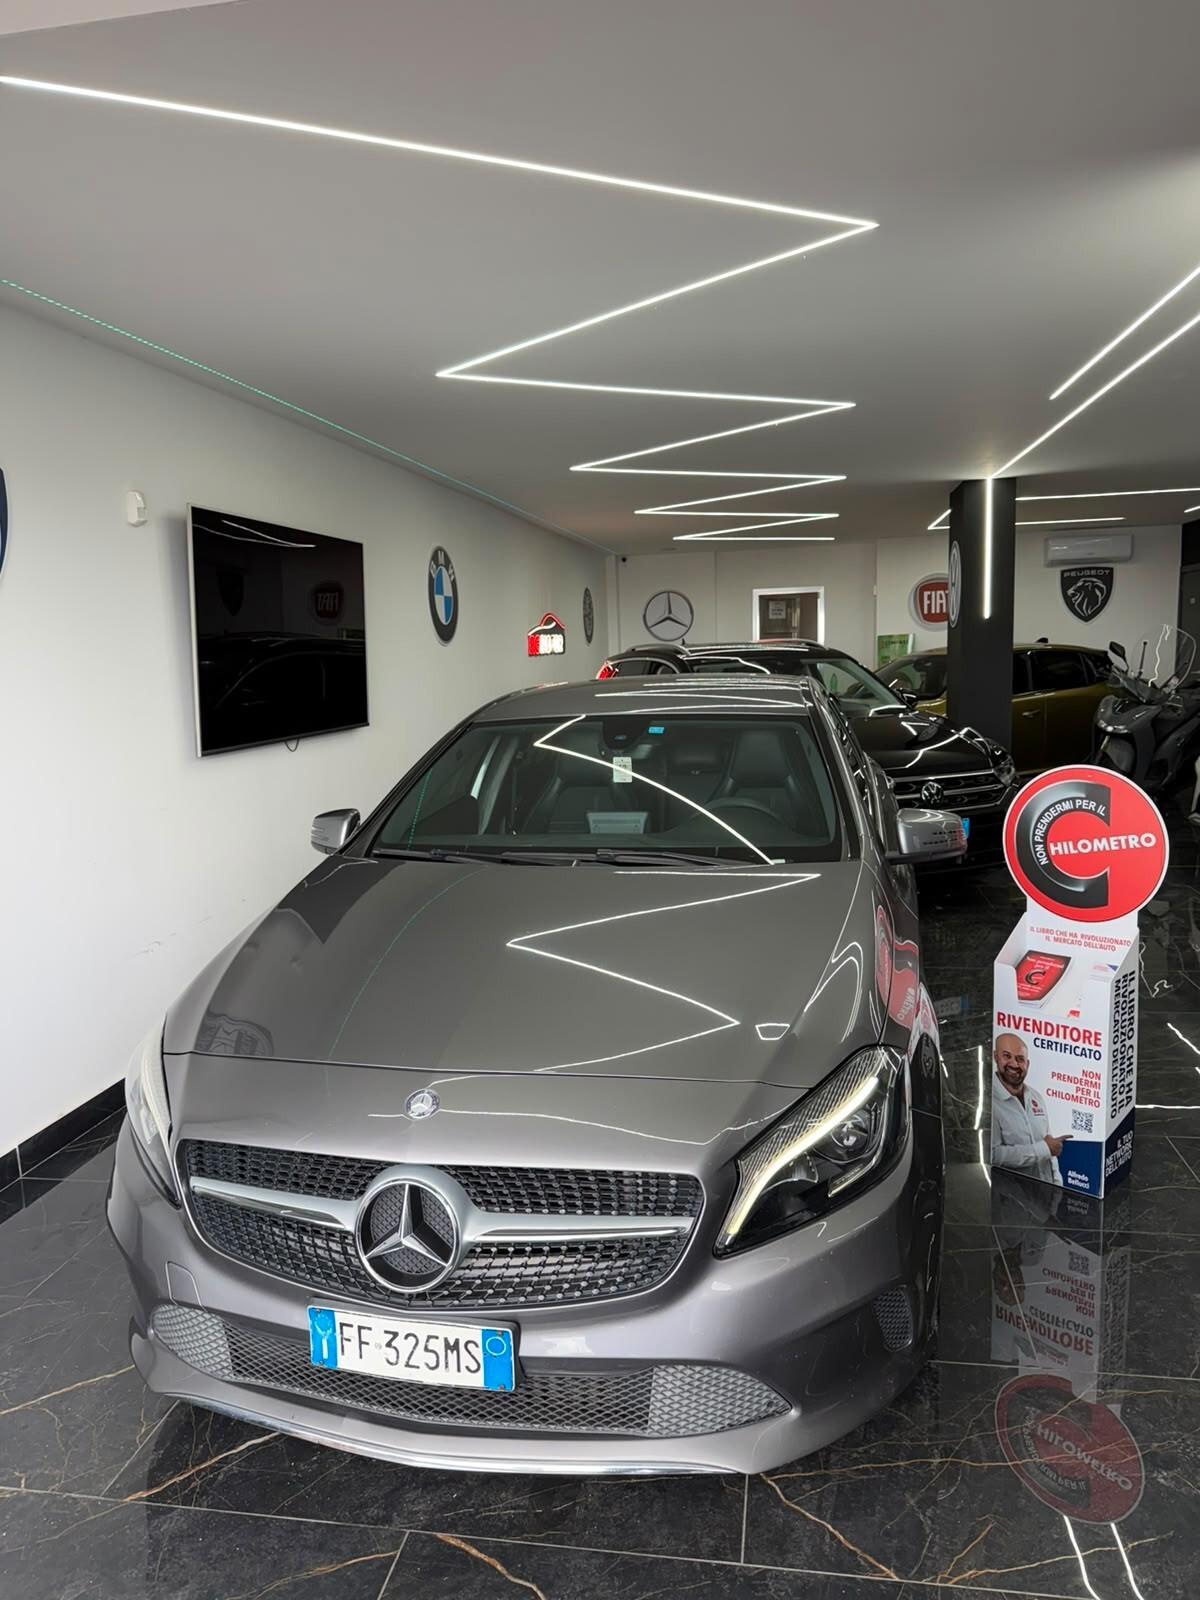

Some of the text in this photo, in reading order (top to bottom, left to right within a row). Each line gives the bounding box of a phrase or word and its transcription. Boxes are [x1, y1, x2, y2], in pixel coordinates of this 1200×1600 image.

[1063, 569, 1110, 577] PEUGEOT
[923, 590, 949, 614] FIA
[1034, 799, 1106, 866] NON PRENDERMI PER IL
[1036, 927, 1054, 935] LIBRO
[1080, 933, 1131, 947] RIVOLUZIONATO
[1053, 936, 1082, 946] MERCATO
[1083, 940, 1117, 952] DELL'AUTO
[996, 1011, 1102, 1047] RIVENDITORE
[1125, 970, 1136, 1107] IL LIBRO CHE HA
[1033, 1037, 1102, 1061] CERTIFICATO
[1110, 979, 1121, 1119] MERCATO DELL'AUTO
[1117, 973, 1128, 1114] RIVOLUZIONATO IL
[1051, 1071, 1101, 1090] PRENDERMI
[1081, 1069, 1101, 1081] NON
[1046, 1088, 1101, 1108] CHILOMETRO
[1075, 1086, 1101, 1099] PER IL
[1106, 1140, 1132, 1167] NETWORK
